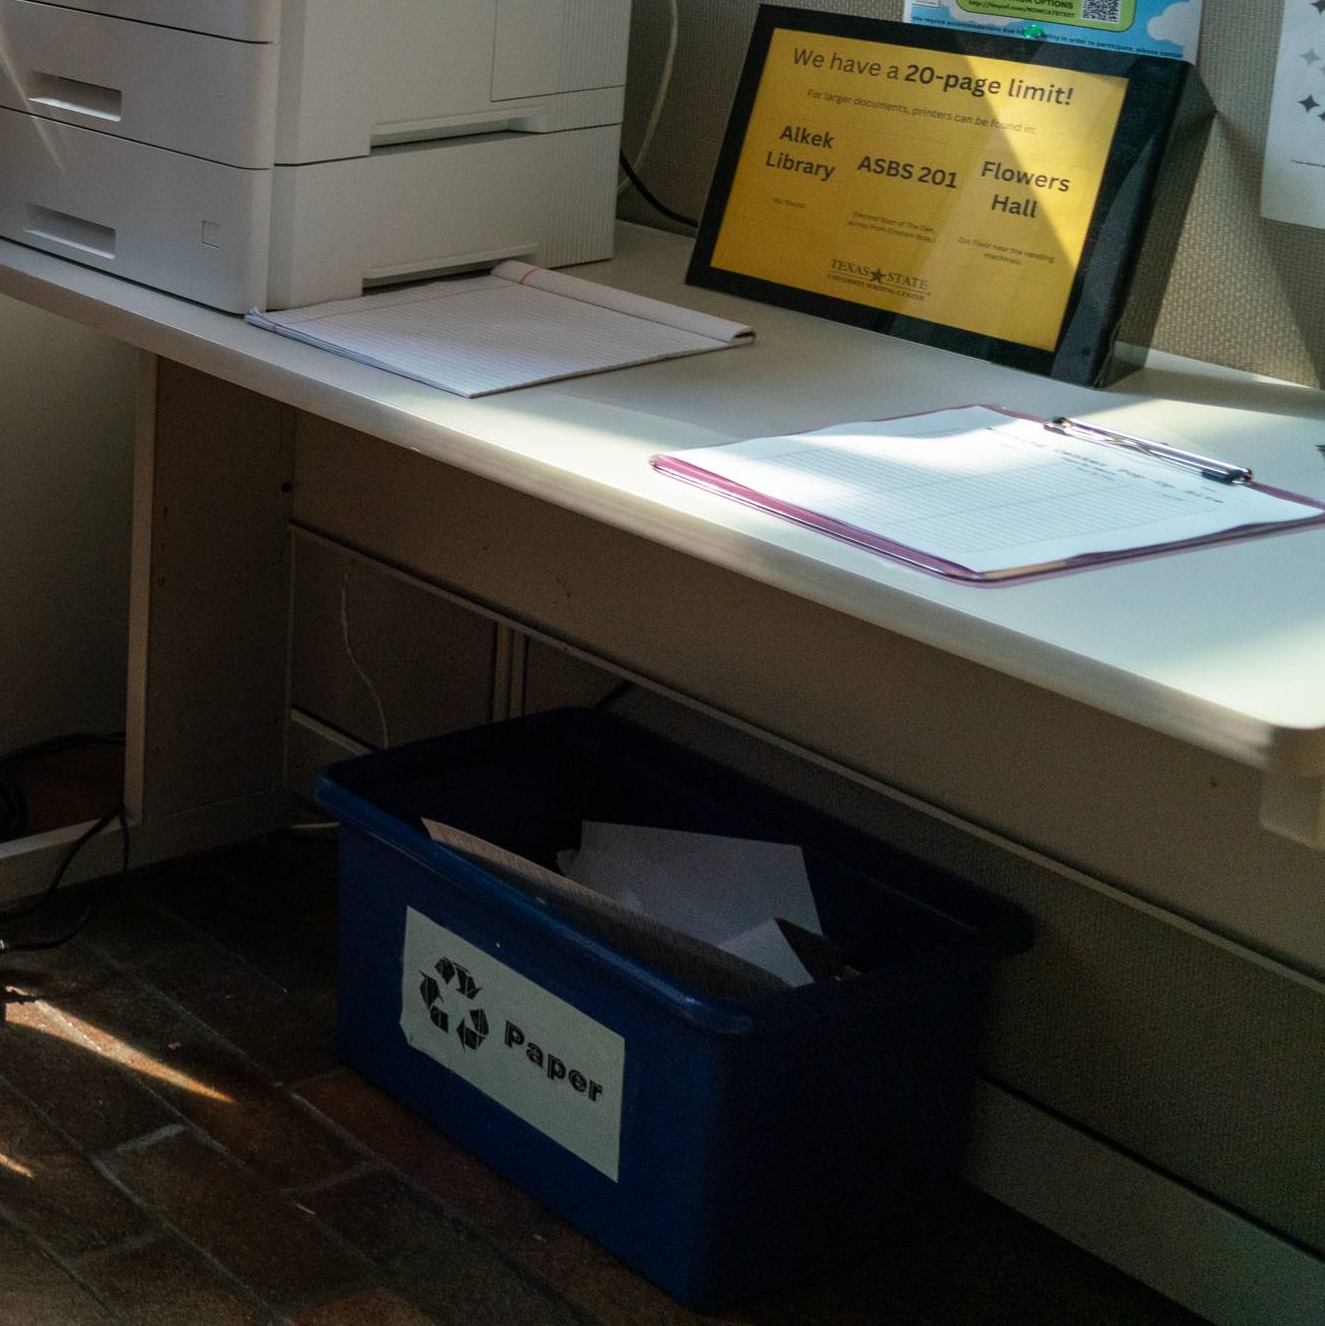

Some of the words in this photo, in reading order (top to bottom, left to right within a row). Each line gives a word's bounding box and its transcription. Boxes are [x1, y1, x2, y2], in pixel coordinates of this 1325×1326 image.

[793, 47, 826, 68] We
[828, 52, 882, 77] have
[886, 65, 900, 81] a
[903, 63, 1002, 98] 20-page
[1007, 77, 1074, 106] limit!
[806, 88, 823, 99] For
[824, 92, 853, 106] larger
[853, 96, 910, 115] documents,
[911, 106, 953, 122] printers
[954, 112, 973, 124] can
[974, 115, 989, 127] be
[990, 118, 1022, 132] found
[778, 124, 835, 150] Alkek
[764, 150, 837, 182] Library
[856, 155, 914, 181] ASBS
[917, 165, 959, 189] 201
[980, 160, 1072, 193] Flowers
[990, 193, 1038, 219] Hall
[830, 257, 870, 276] TEXAS
[887, 271, 929, 291] STATE
[504, 1020, 603, 1102] Paper
